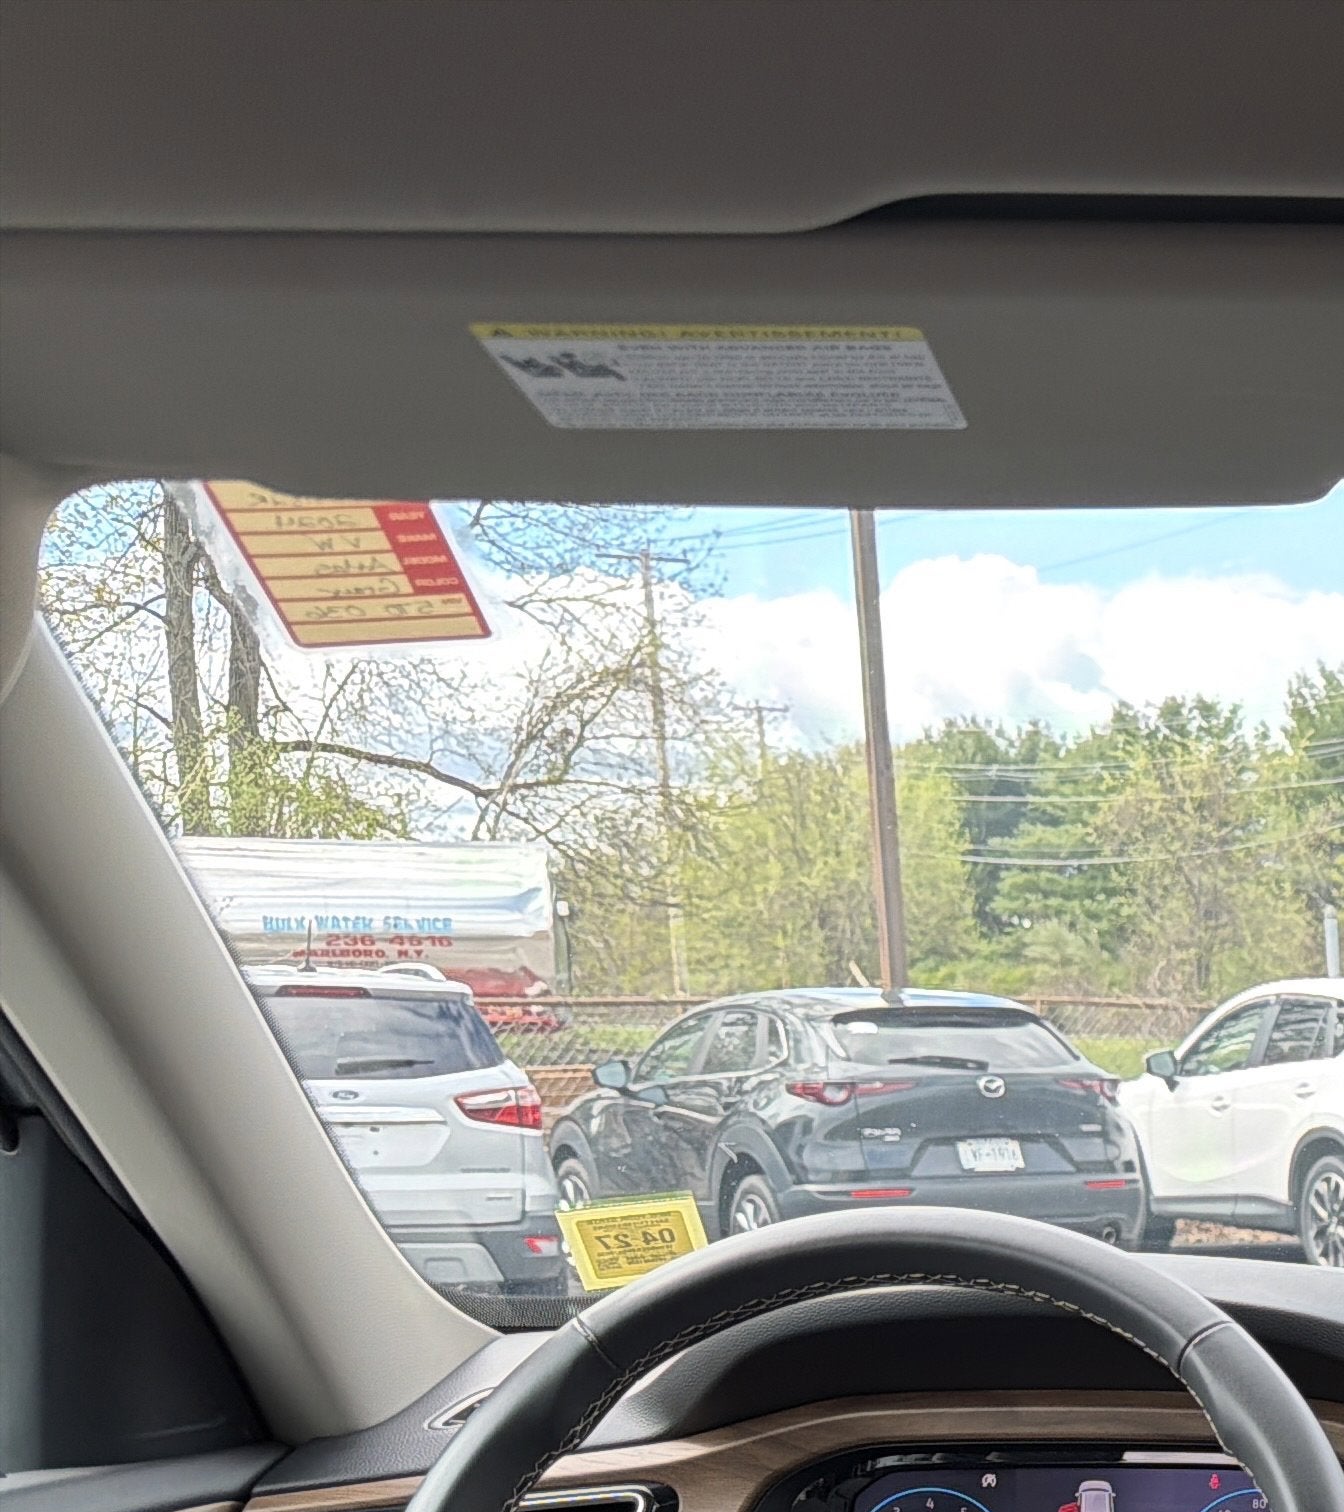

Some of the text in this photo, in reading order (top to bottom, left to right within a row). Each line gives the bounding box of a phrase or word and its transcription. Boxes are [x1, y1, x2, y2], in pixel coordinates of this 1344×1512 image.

[314, 915, 374, 932] WATER
[383, 916, 454, 932] SERVICE
[325, 933, 376, 947] 236
[926, 1497, 935, 1510] 4
[1252, 1498, 1267, 1509] 80
